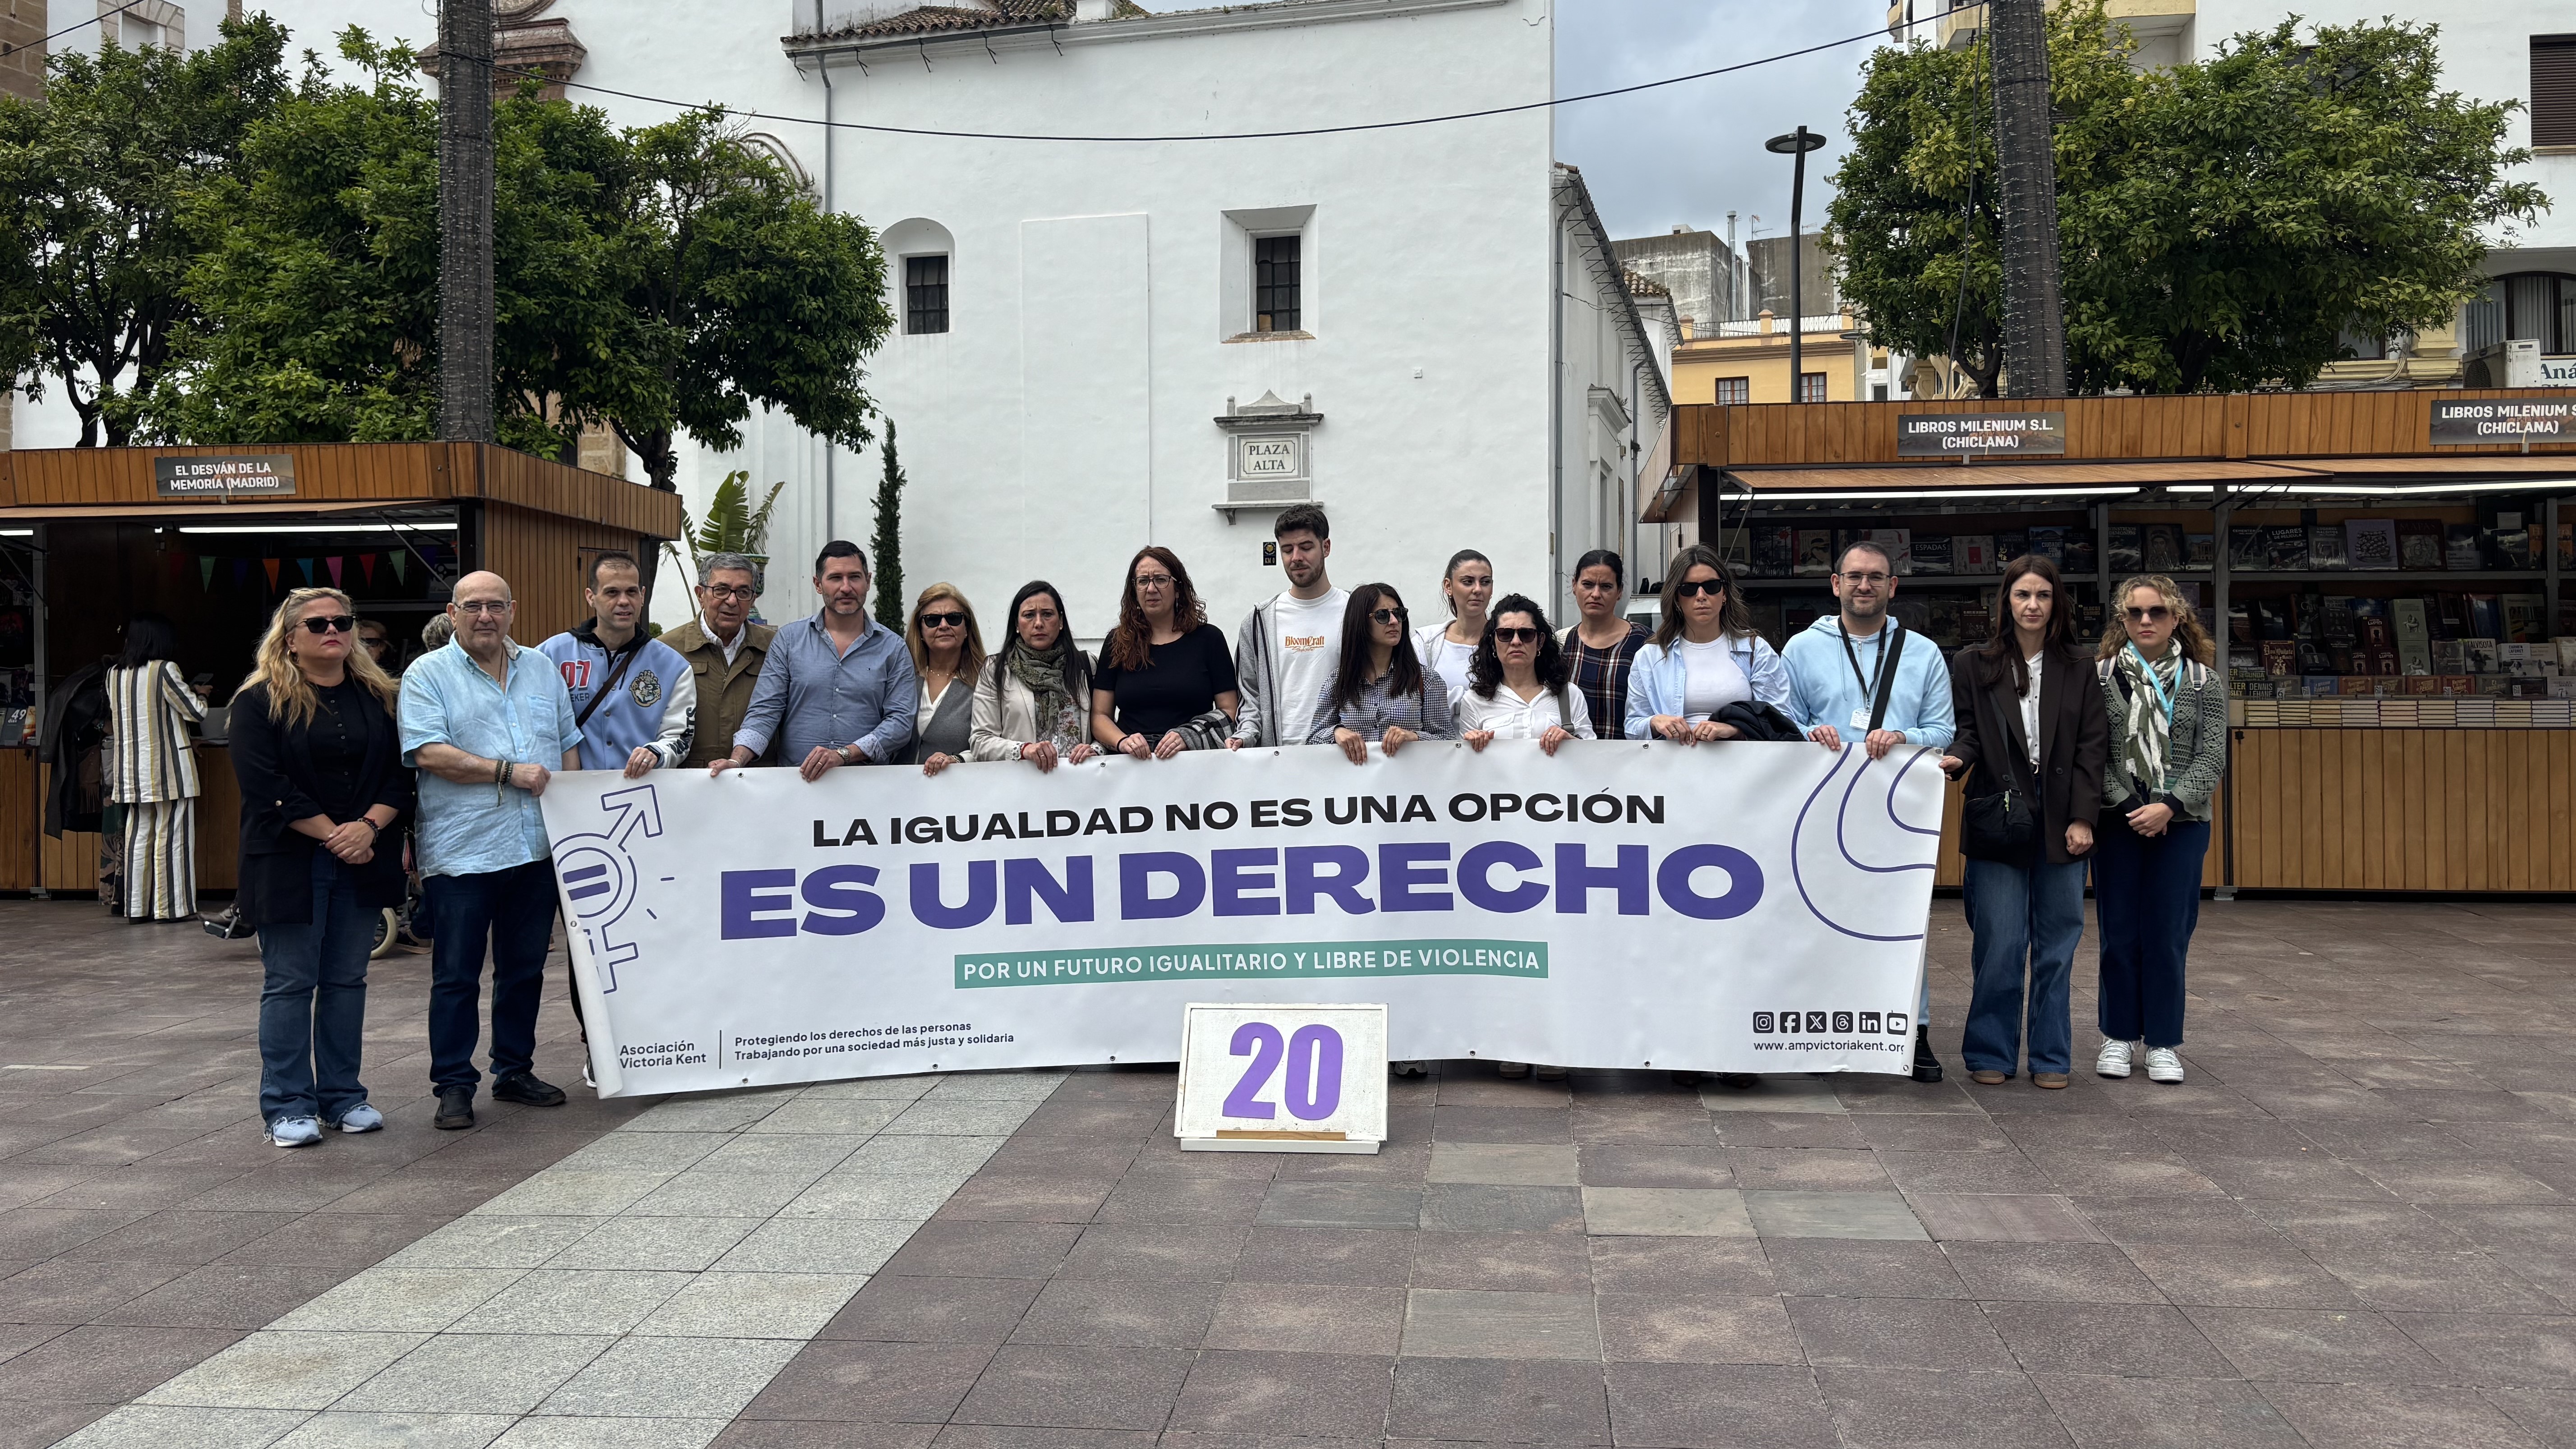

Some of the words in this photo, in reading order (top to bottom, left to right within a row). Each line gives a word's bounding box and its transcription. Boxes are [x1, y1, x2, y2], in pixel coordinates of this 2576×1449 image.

[2442, 406, 2493, 418] LIBROS
[2498, 405, 2567, 417] MILENIUM
[1909, 422, 1956, 433] LIBROS
[1961, 420, 2025, 431] MILENIUM
[2030, 419, 2053, 430] S.L.
[2478, 419, 2559, 436] (CHICLANA)
[1942, 434, 2019, 449] (CHICLANA)
[1249, 445, 1290, 455] PLAZA
[175, 465, 189, 475] EL
[192, 461, 235, 475] DESVÁN
[239, 463, 253, 473] DE
[257, 463, 271, 472] LA
[1253, 460, 1285, 470] ALTA
[170, 478, 224, 490] MEMORIA
[226, 476, 279, 490] (MADRID)
[560, 659, 591, 691] 07
[570, 692, 589, 702] EKER
[11, 709, 27, 720] 49
[814, 819, 878, 847] LA
[891, 807, 1153, 844] IGUALDAD
[1166, 802, 1238, 831] NO
[1251, 798, 1312, 827] ES
[1325, 795, 1436, 825] UNA
[1449, 787, 1664, 824] OPCIÓN
[721, 865, 885, 940] ES
[910, 855, 1094, 929] UN
[1119, 841, 1764, 920] DERECHO
[965, 963, 1010, 980] POR
[1018, 961, 1046, 977] UN
[1055, 957, 1141, 976] FUTURO
[1150, 953, 1286, 972] IGUALITARIO
[1294, 953, 1306, 969] Y
[1314, 951, 1375, 968] LIBRE
[1384, 950, 1411, 967] DE
[1418, 949, 1539, 969] VIOLENCIA
[736, 1033, 807, 1046] Protegiendo
[811, 1032, 826, 1041] los
[829, 1028, 882, 1039] derechos
[885, 1026, 899, 1035] de
[902, 1025, 917, 1034] las
[920, 1024, 971, 1035] personas
[620, 1040, 694, 1055] Asociación
[735, 1047, 800, 1060] Trabajando
[804, 1047, 822, 1057] por
[848, 1039, 900, 1051] sociedad
[903, 1037, 925, 1047] más
[928, 1037, 955, 1048] justa
[958, 1038, 964, 1046] y
[967, 1033, 1013, 1044] solidaria
[620, 1055, 672, 1068] Victoria
[676, 1054, 706, 1064] Kent
[1222, 1022, 1343, 1120] 20
